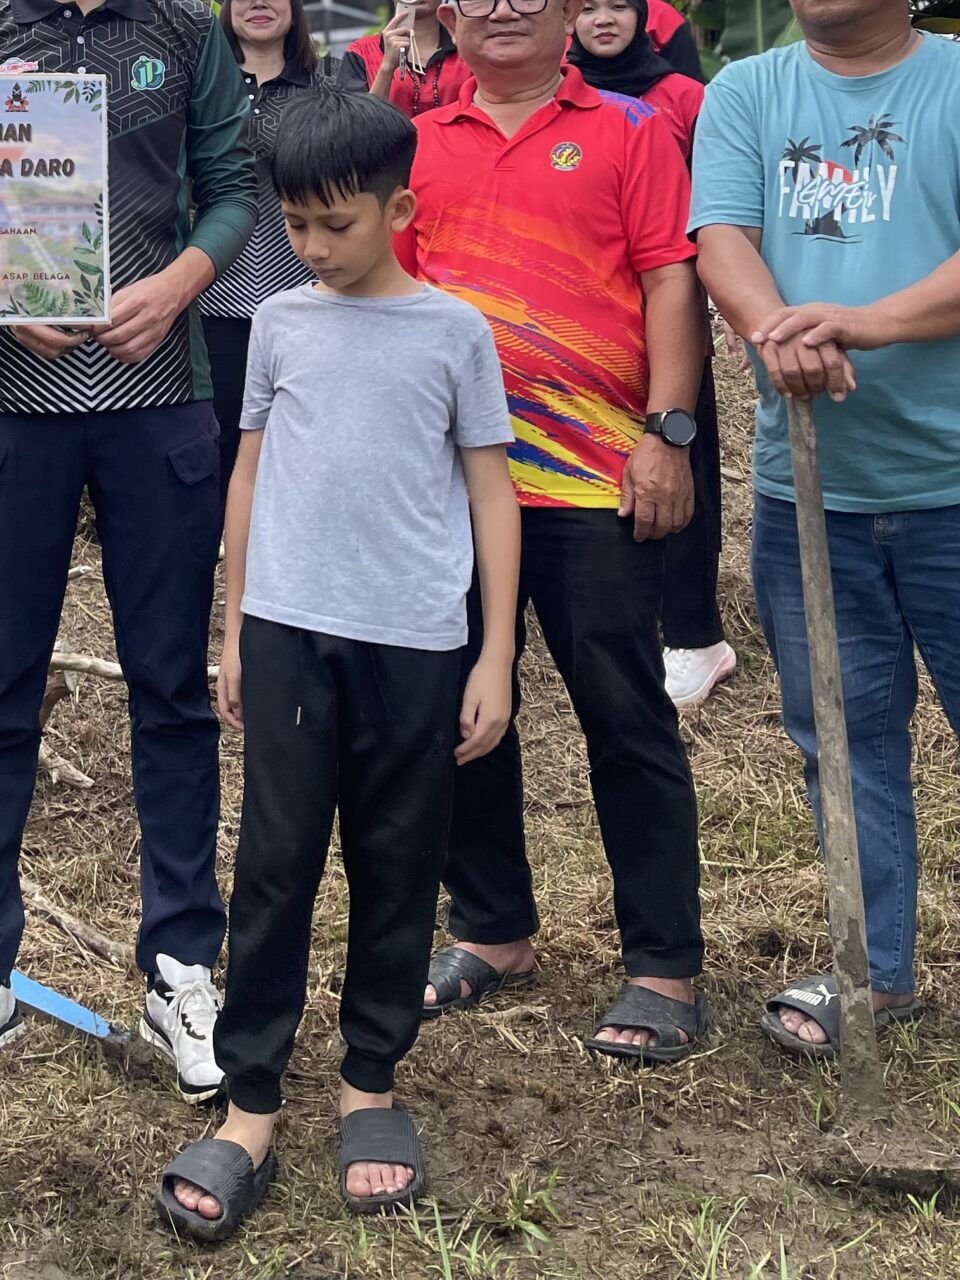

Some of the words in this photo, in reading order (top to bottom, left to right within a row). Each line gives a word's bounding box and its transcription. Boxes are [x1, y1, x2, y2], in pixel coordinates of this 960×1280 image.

[20, 158, 75, 177] DARO
[778, 160, 898, 223] FAMILY
[33, 273, 71, 281] BELAGA
[784, 988, 825, 1006] PUMA
